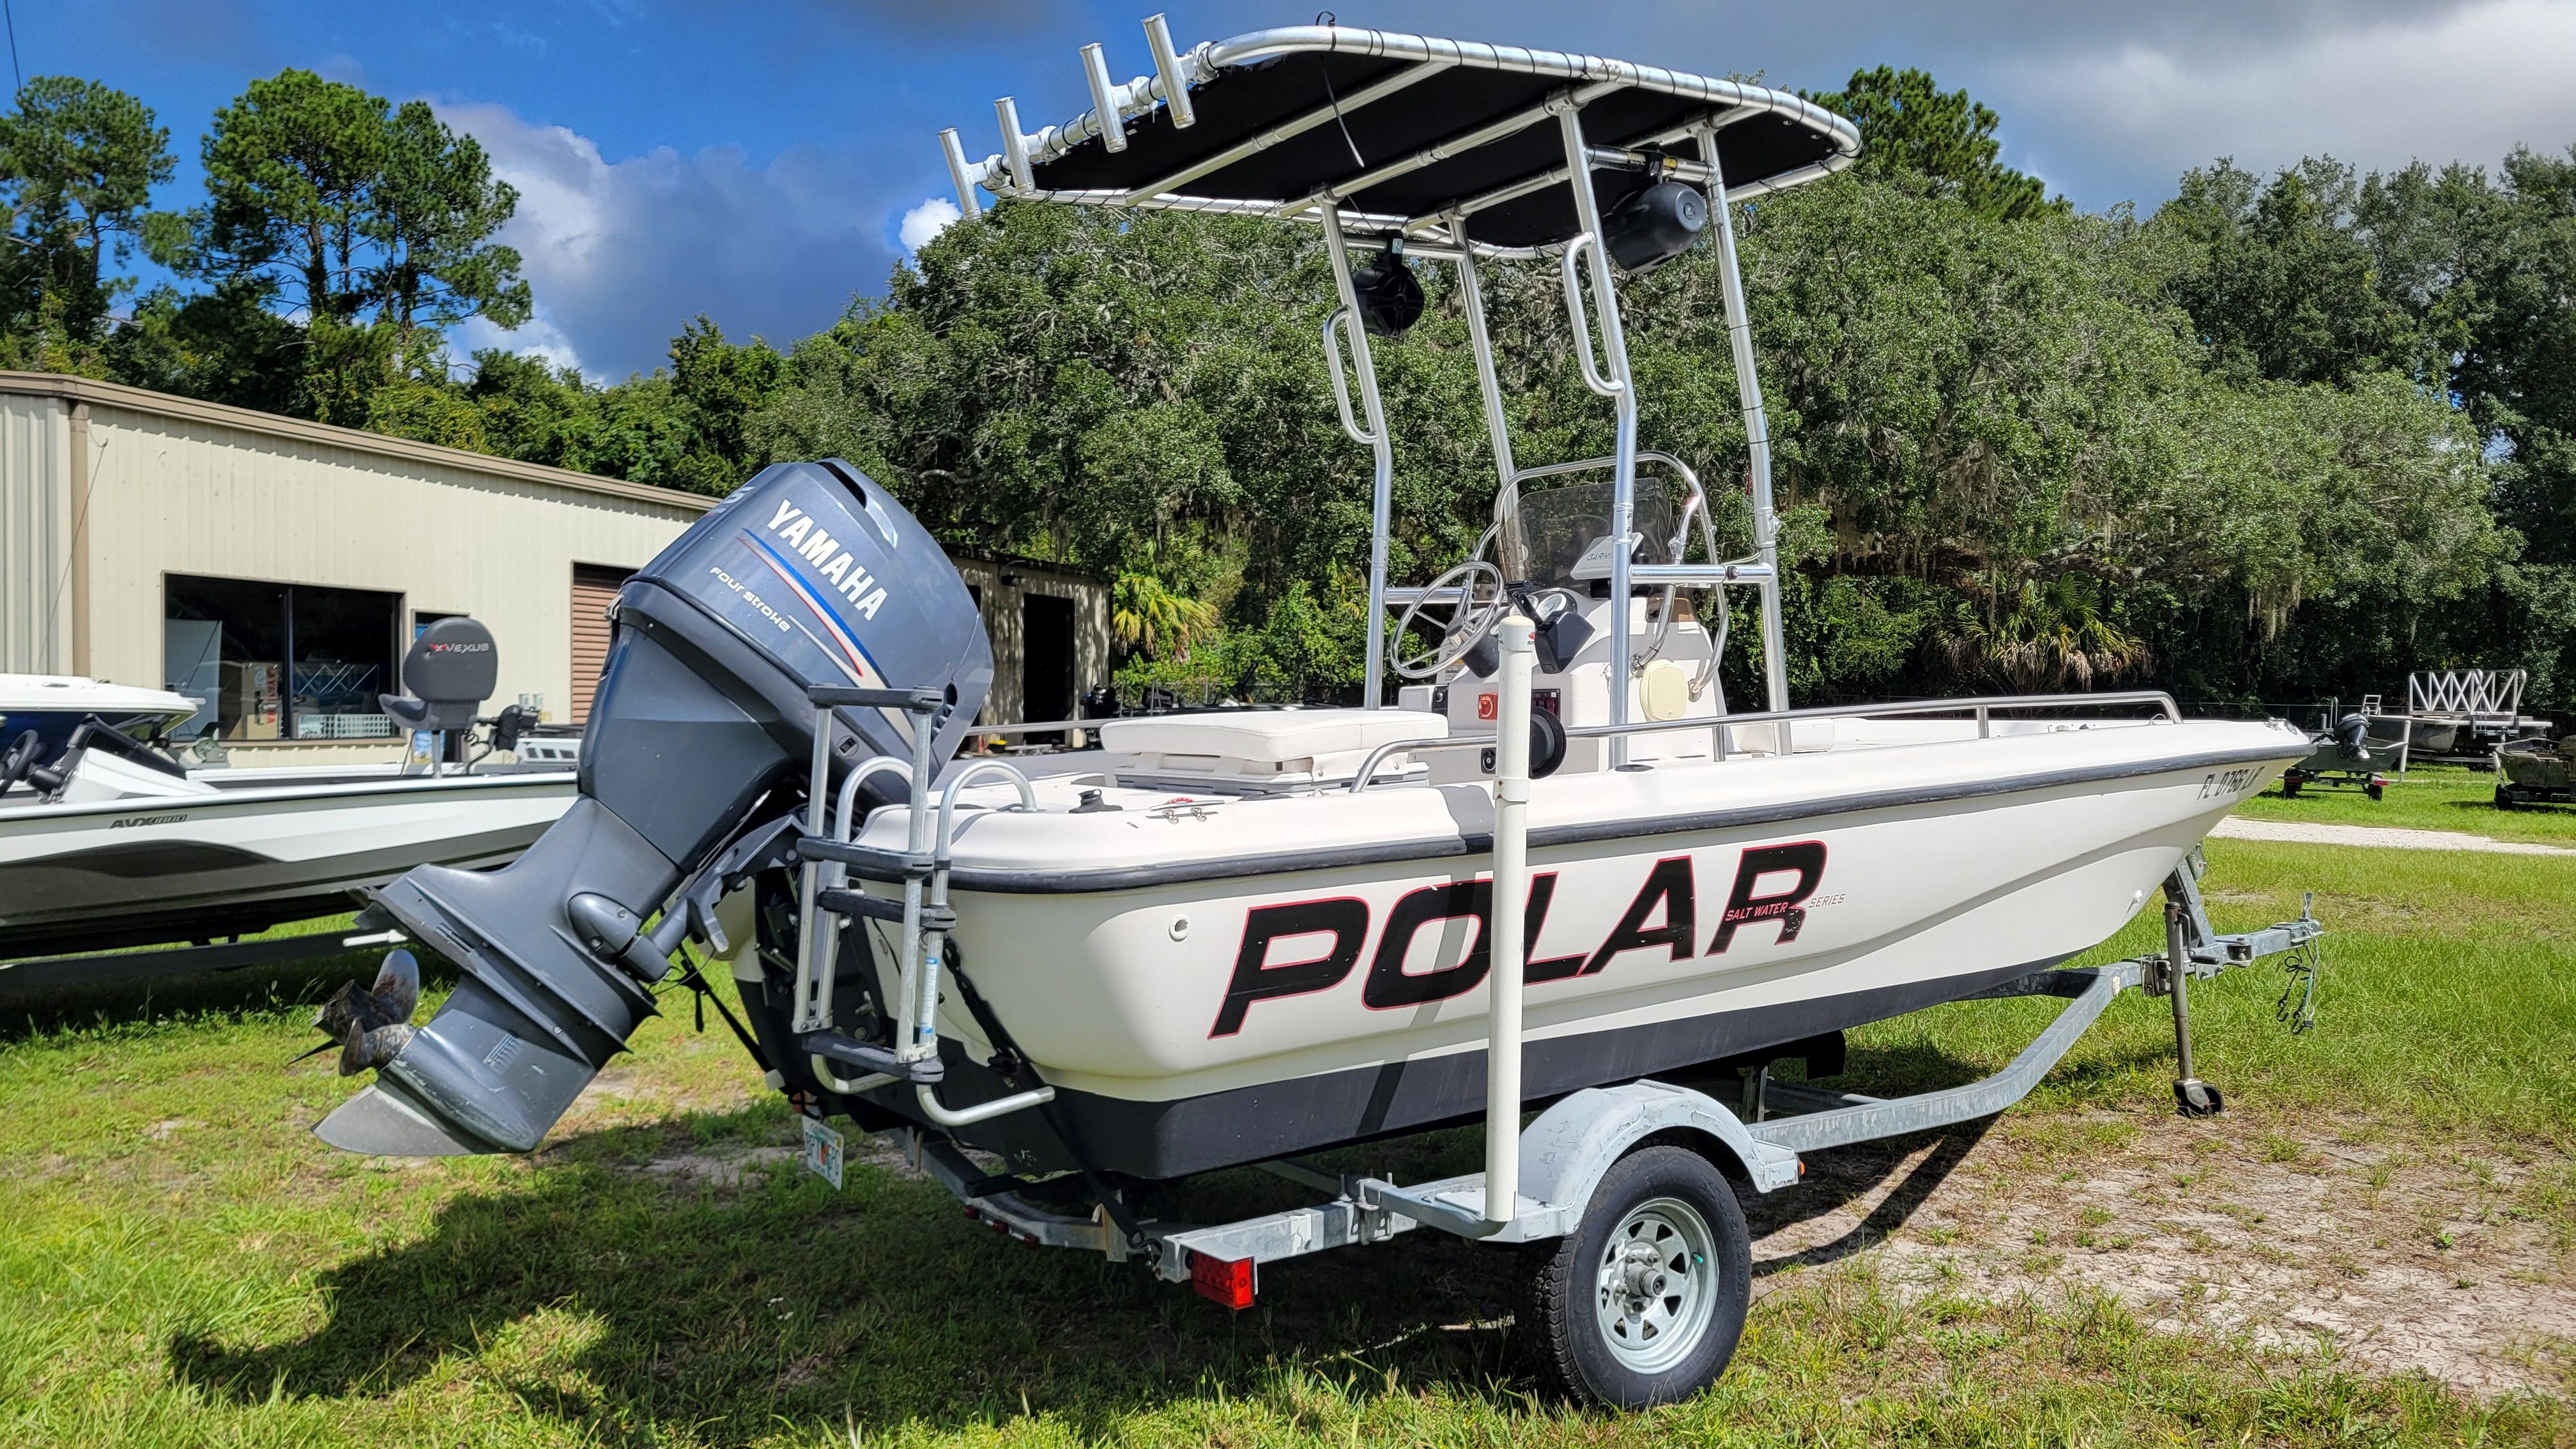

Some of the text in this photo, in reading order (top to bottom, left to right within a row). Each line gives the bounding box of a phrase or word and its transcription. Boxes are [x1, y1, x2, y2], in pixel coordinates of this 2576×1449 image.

[767, 499, 888, 622] YAMAHA
[1587, 551, 1613, 562] GARM
[709, 567, 745, 592] Four
[447, 643, 489, 654] VEXUS
[2196, 773, 2216, 801] FL
[1725, 893, 1846, 922] SALT WATER SERIES
[1208, 839, 1829, 1041] POLAR
